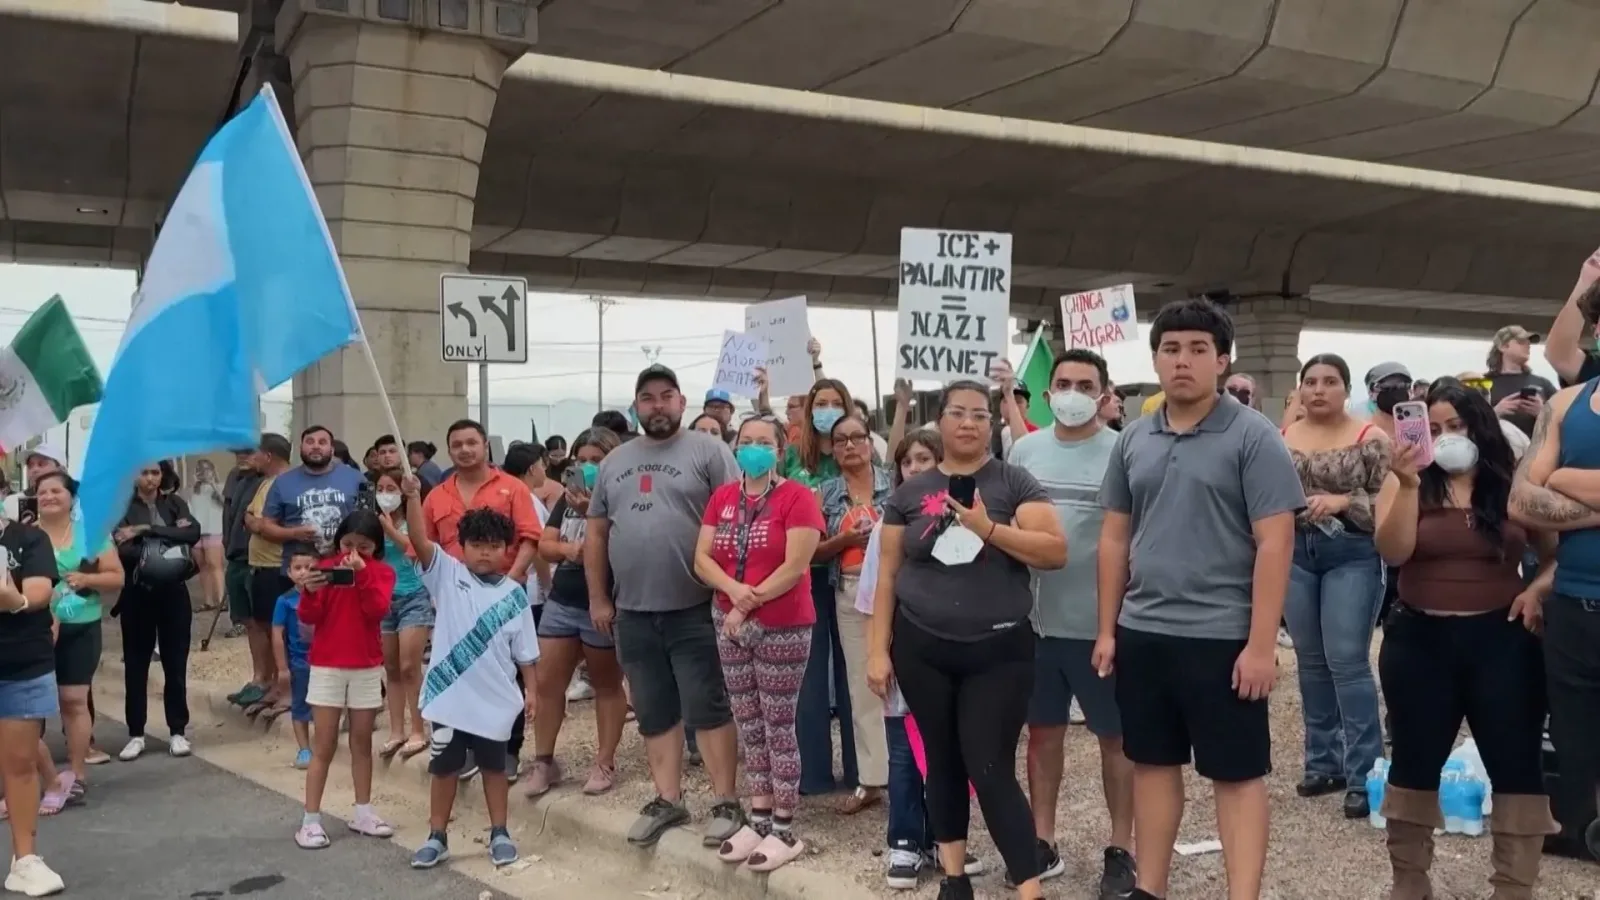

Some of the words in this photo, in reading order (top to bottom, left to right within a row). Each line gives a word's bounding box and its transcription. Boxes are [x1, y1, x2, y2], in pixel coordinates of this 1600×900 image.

[937, 233, 980, 259] ICE
[984, 238, 1000, 256] +
[901, 261, 1006, 293] PALINTIR
[941, 295, 967, 311] =
[1065, 291, 1105, 315] CHINGA
[910, 311, 987, 342] NAZI
[1070, 313, 1091, 333] LA
[724, 335, 757, 352] NO
[1071, 322, 1125, 350] MIGRA
[445, 344, 483, 357] ONLY
[899, 344, 998, 377] SKYNET
[616, 468, 633, 483] THE
[637, 464, 682, 478] COOLEST
[631, 502, 653, 511] POP
